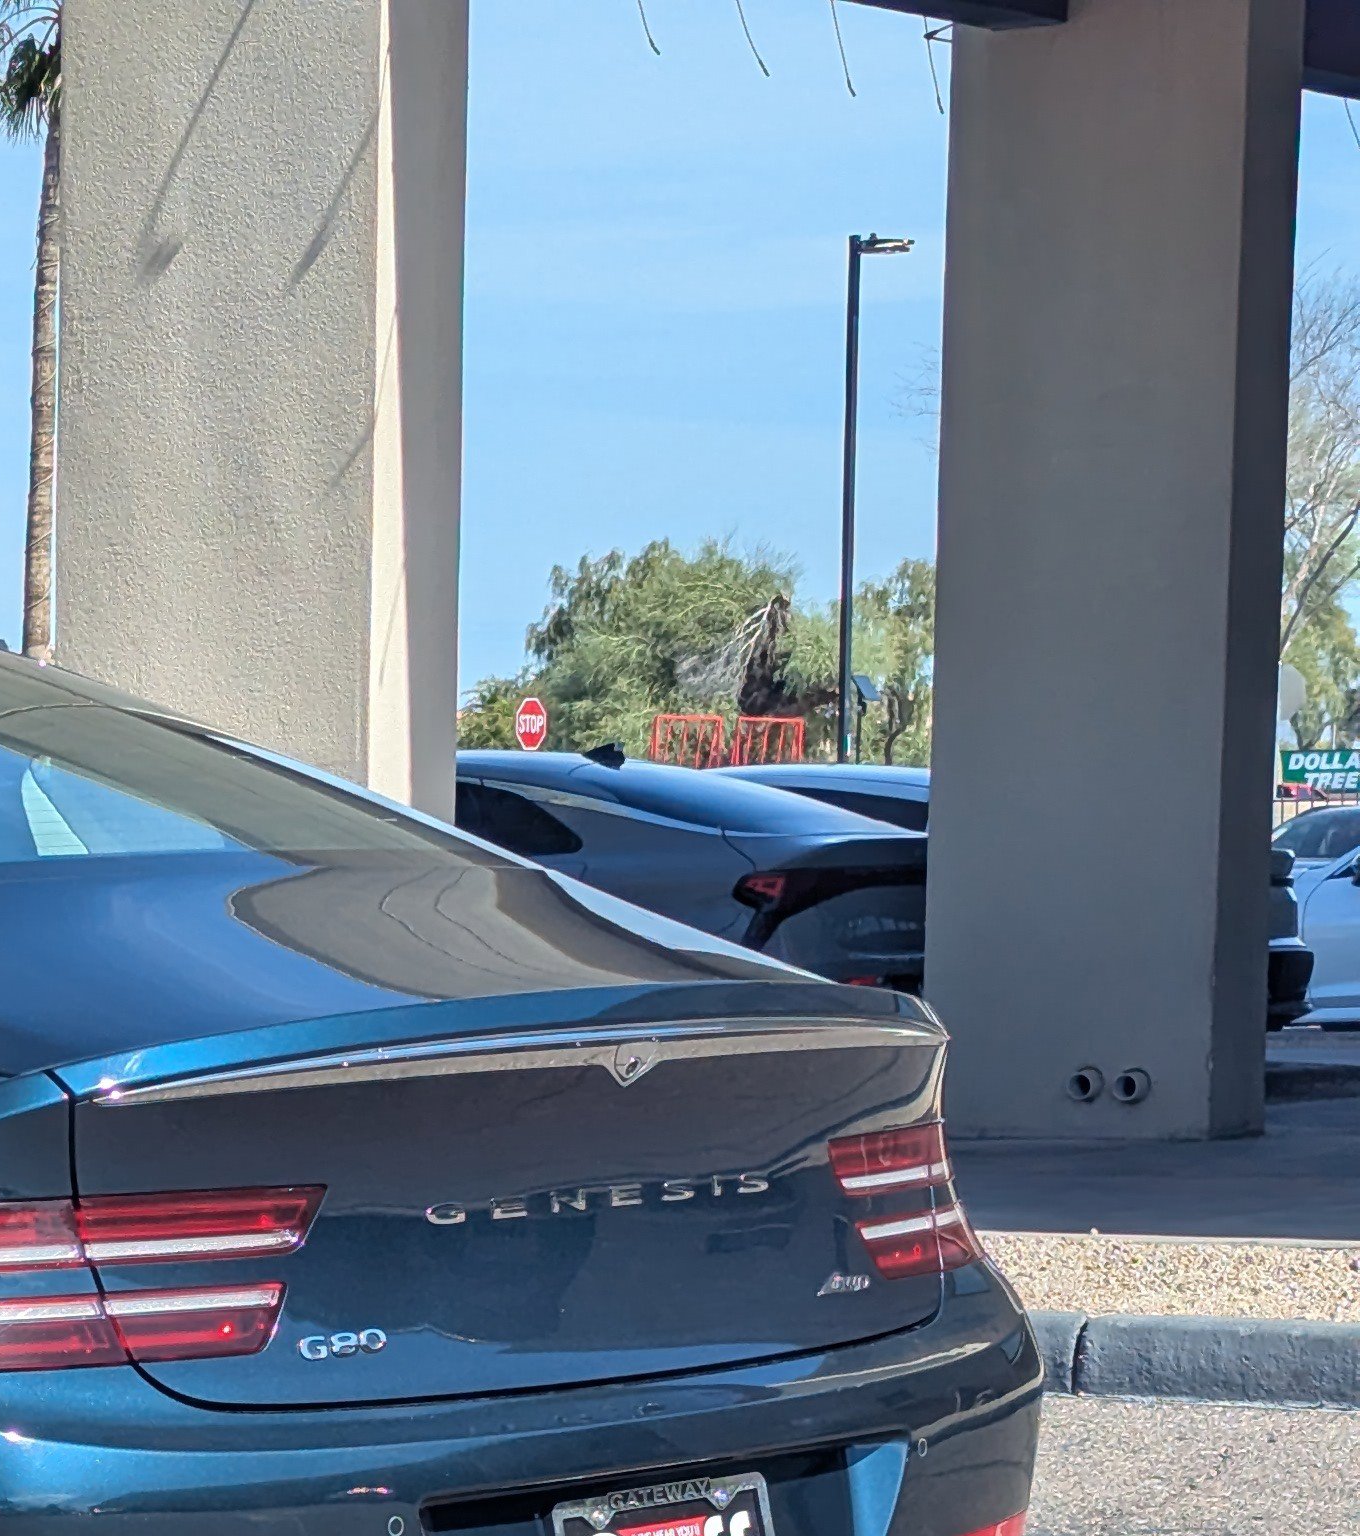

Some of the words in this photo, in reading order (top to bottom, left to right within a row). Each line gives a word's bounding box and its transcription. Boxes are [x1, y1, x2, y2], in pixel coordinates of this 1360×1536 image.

[519, 714, 544, 734] STOP
[1288, 752, 1360, 770] DOLLA
[1304, 772, 1359, 790] TREE
[425, 1173, 770, 1226] GENESIS
[297, 1326, 387, 1362] G80
[609, 1478, 711, 1510] GATEWAY
